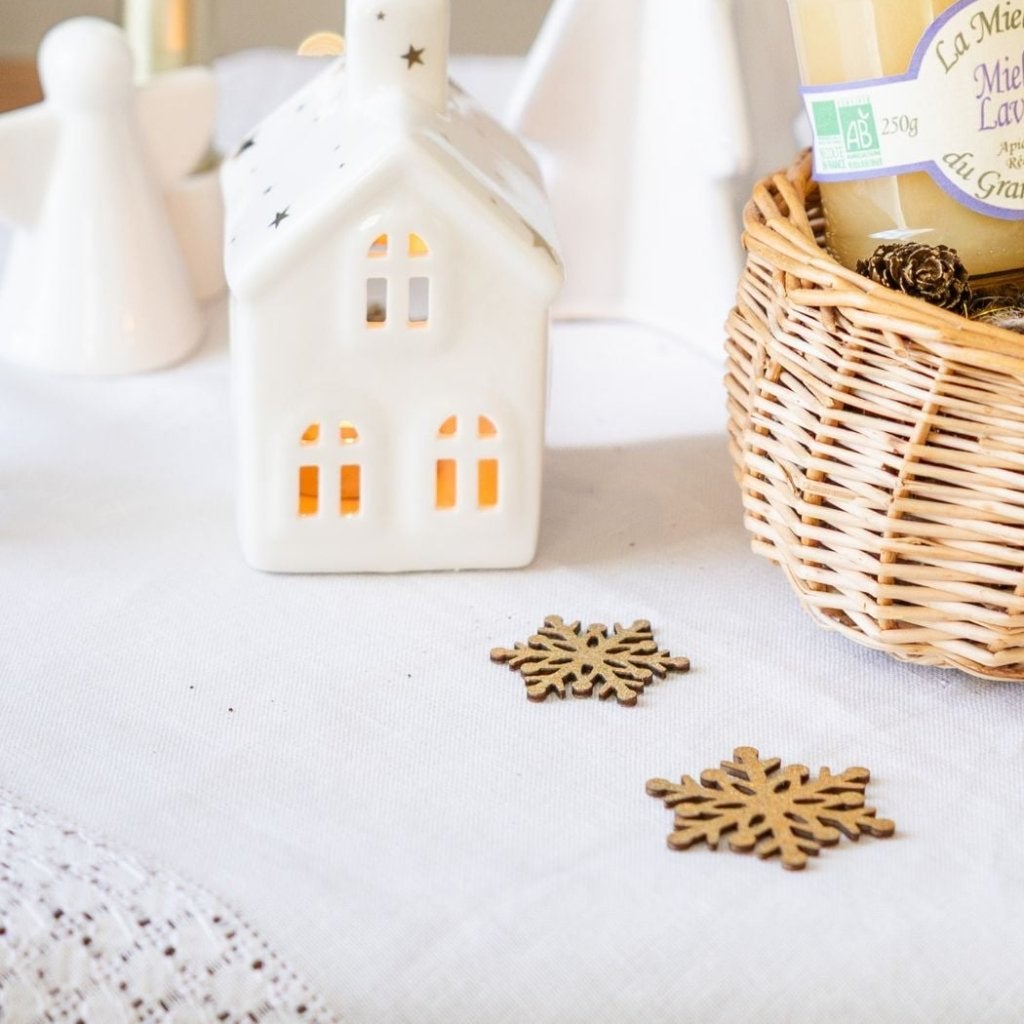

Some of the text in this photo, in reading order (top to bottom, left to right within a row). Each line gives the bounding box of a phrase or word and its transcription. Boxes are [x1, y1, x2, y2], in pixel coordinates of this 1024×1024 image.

[936, 30, 970, 74] La
[847, 118, 873, 151] AB
[881, 114, 919, 137] 250g
[942, 152, 975, 181] du
